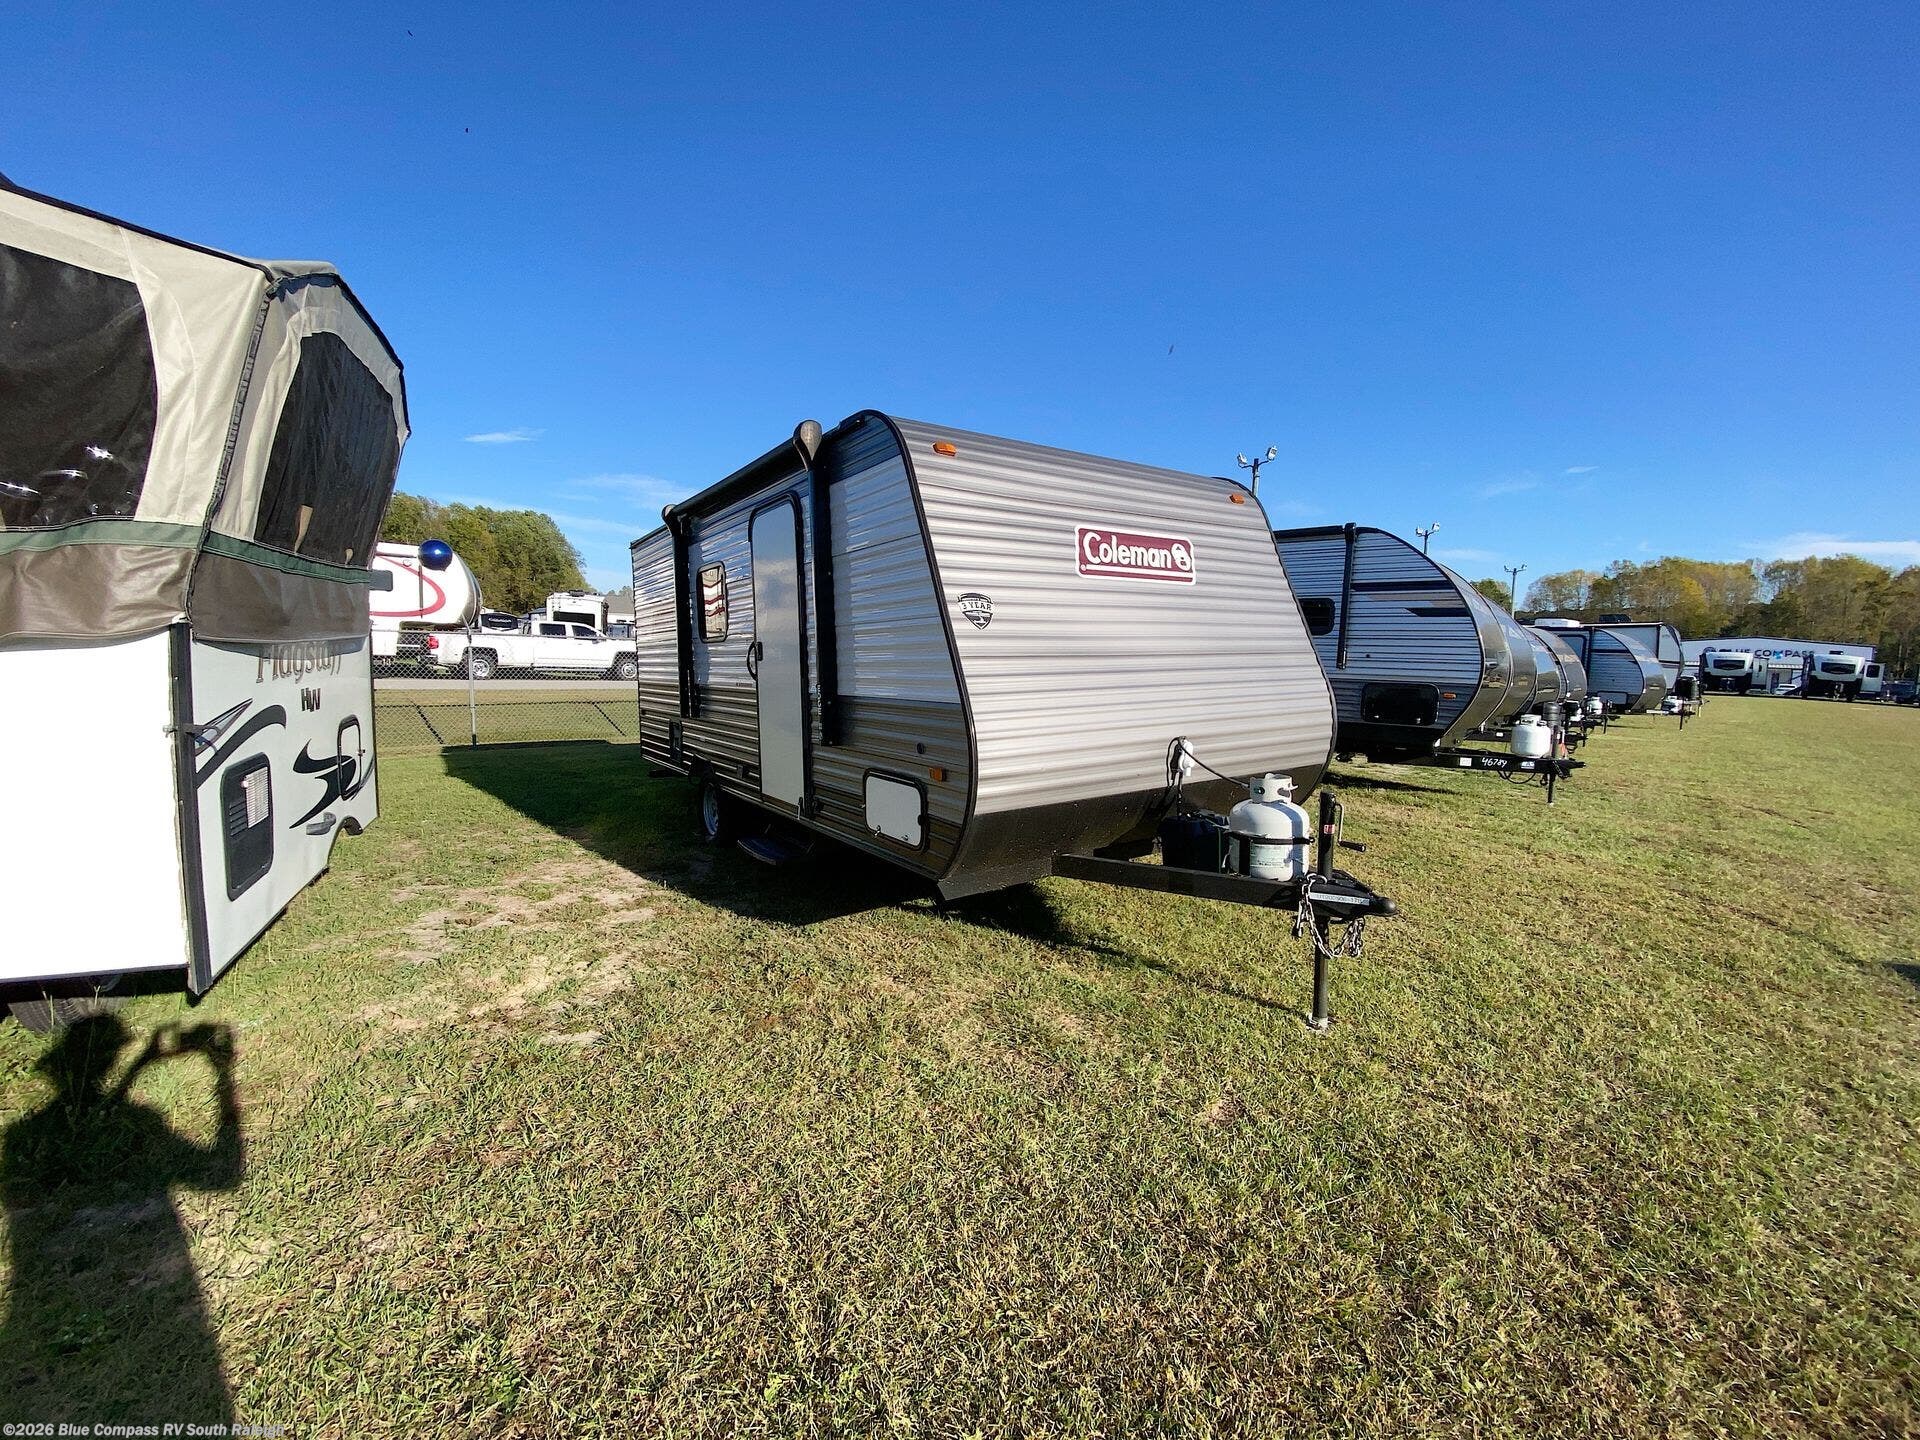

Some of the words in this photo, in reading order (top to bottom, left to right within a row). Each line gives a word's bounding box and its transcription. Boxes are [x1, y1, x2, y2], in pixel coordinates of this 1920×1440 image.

[1083, 531, 1172, 569] Coleman
[961, 602, 968, 610] 3
[968, 601, 992, 611] YEAR
[301, 687, 321, 712] HW
